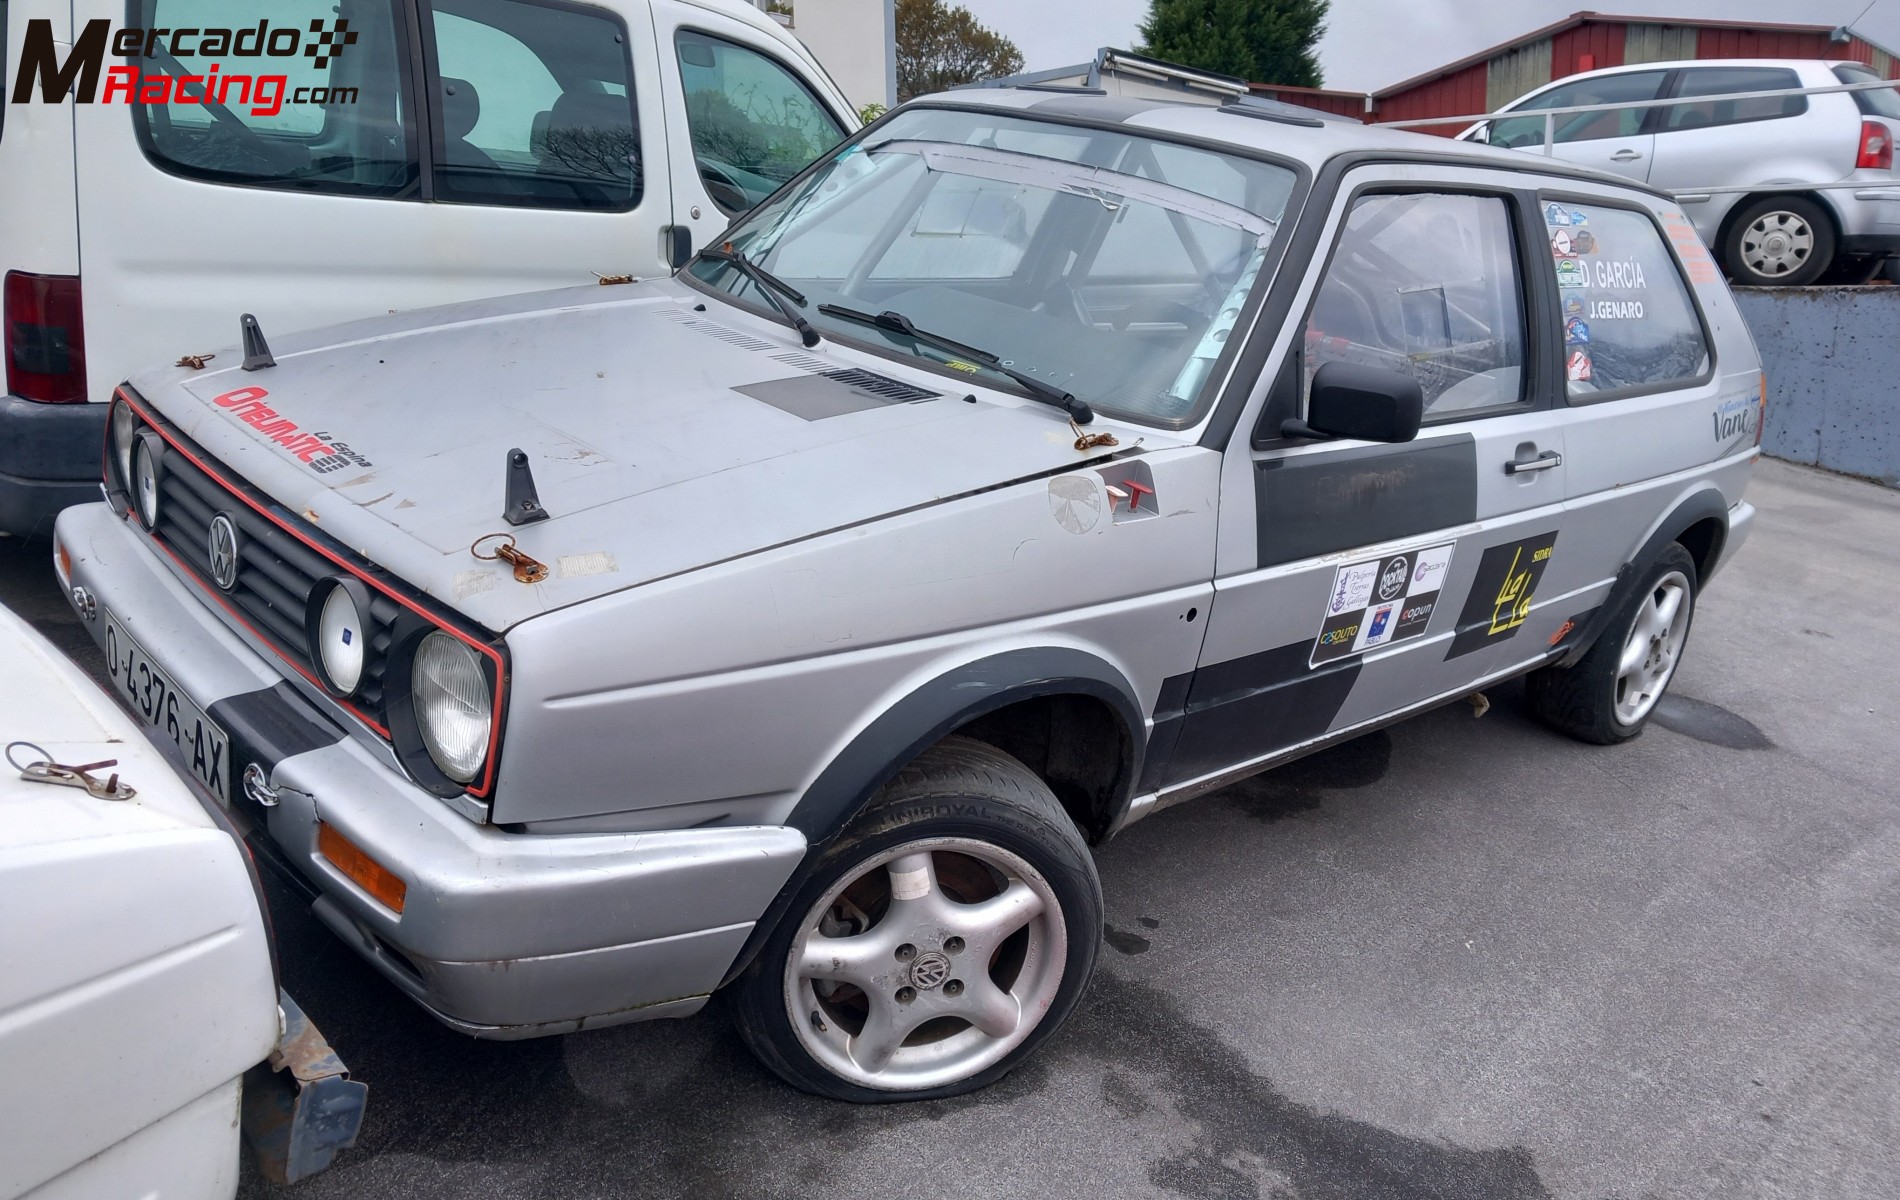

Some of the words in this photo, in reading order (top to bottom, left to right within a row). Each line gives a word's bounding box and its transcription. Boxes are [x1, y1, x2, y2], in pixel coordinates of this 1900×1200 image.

[1595, 256, 1647, 289] GARCÍA
[1589, 301, 1644, 319] J.GENARO
[313, 431, 333, 441] La
[330, 442, 373, 468] Espina
